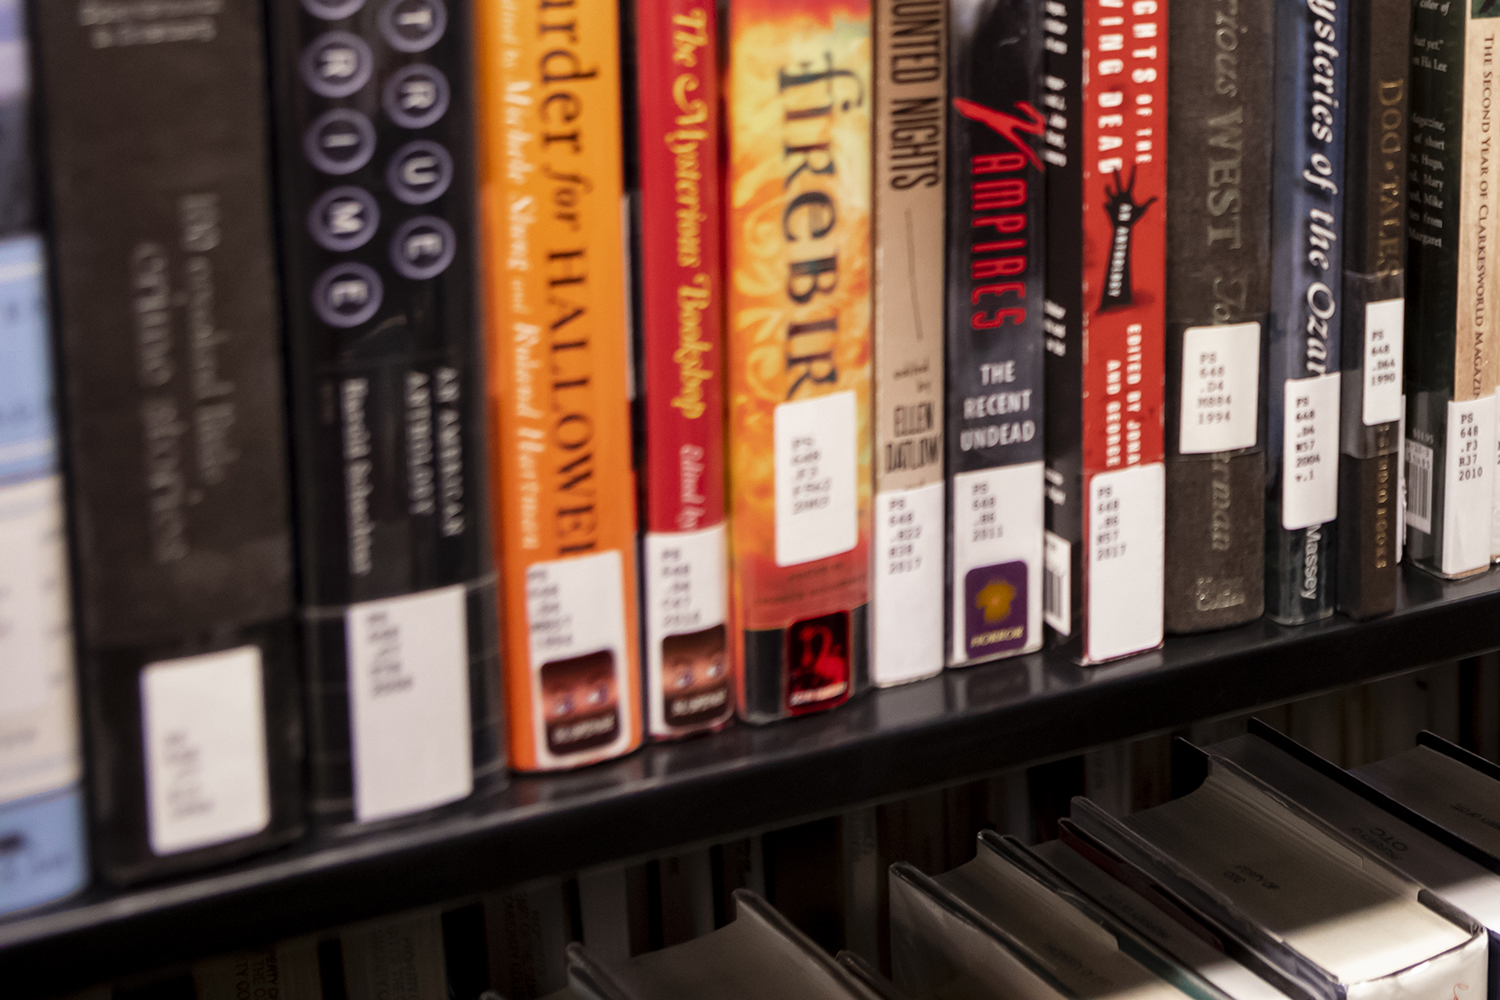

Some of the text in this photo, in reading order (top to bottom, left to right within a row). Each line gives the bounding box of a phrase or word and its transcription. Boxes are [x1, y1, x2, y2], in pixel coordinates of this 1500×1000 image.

[672, 8, 707, 67] The
[1097, 90, 1123, 174] DEAD
[1135, 93, 1152, 117] OF
[664, 73, 708, 268] Mysterious
[888, 95, 940, 190] NIGHTS
[1135, 127, 1152, 164] THE
[542, 160, 594, 231] for
[1206, 105, 1243, 249] WEST
[1303, 152, 1338, 195] of
[1475, 34, 1494, 327] THE SECOND YEAR OF CLARKESWORLD
[952, 97, 1046, 329] VAMPIRES
[1308, 208, 1337, 270] the
[671, 272, 713, 420] Bookshop
[980, 360, 1016, 386] THE
[1127, 323, 1142, 386] EDITED
[963, 388, 1033, 419] RECENT
[1106, 359, 1121, 467] AND GEORGE
[1460, 426, 1478, 437] 648
[1461, 413, 1473, 424] PS
[960, 420, 1036, 451] UNDEAD
[1459, 455, 1477, 467] R37
[1461, 441, 1478, 452] .F3
[1459, 467, 1483, 481] 2010
[1301, 524, 1321, 600] Massey
